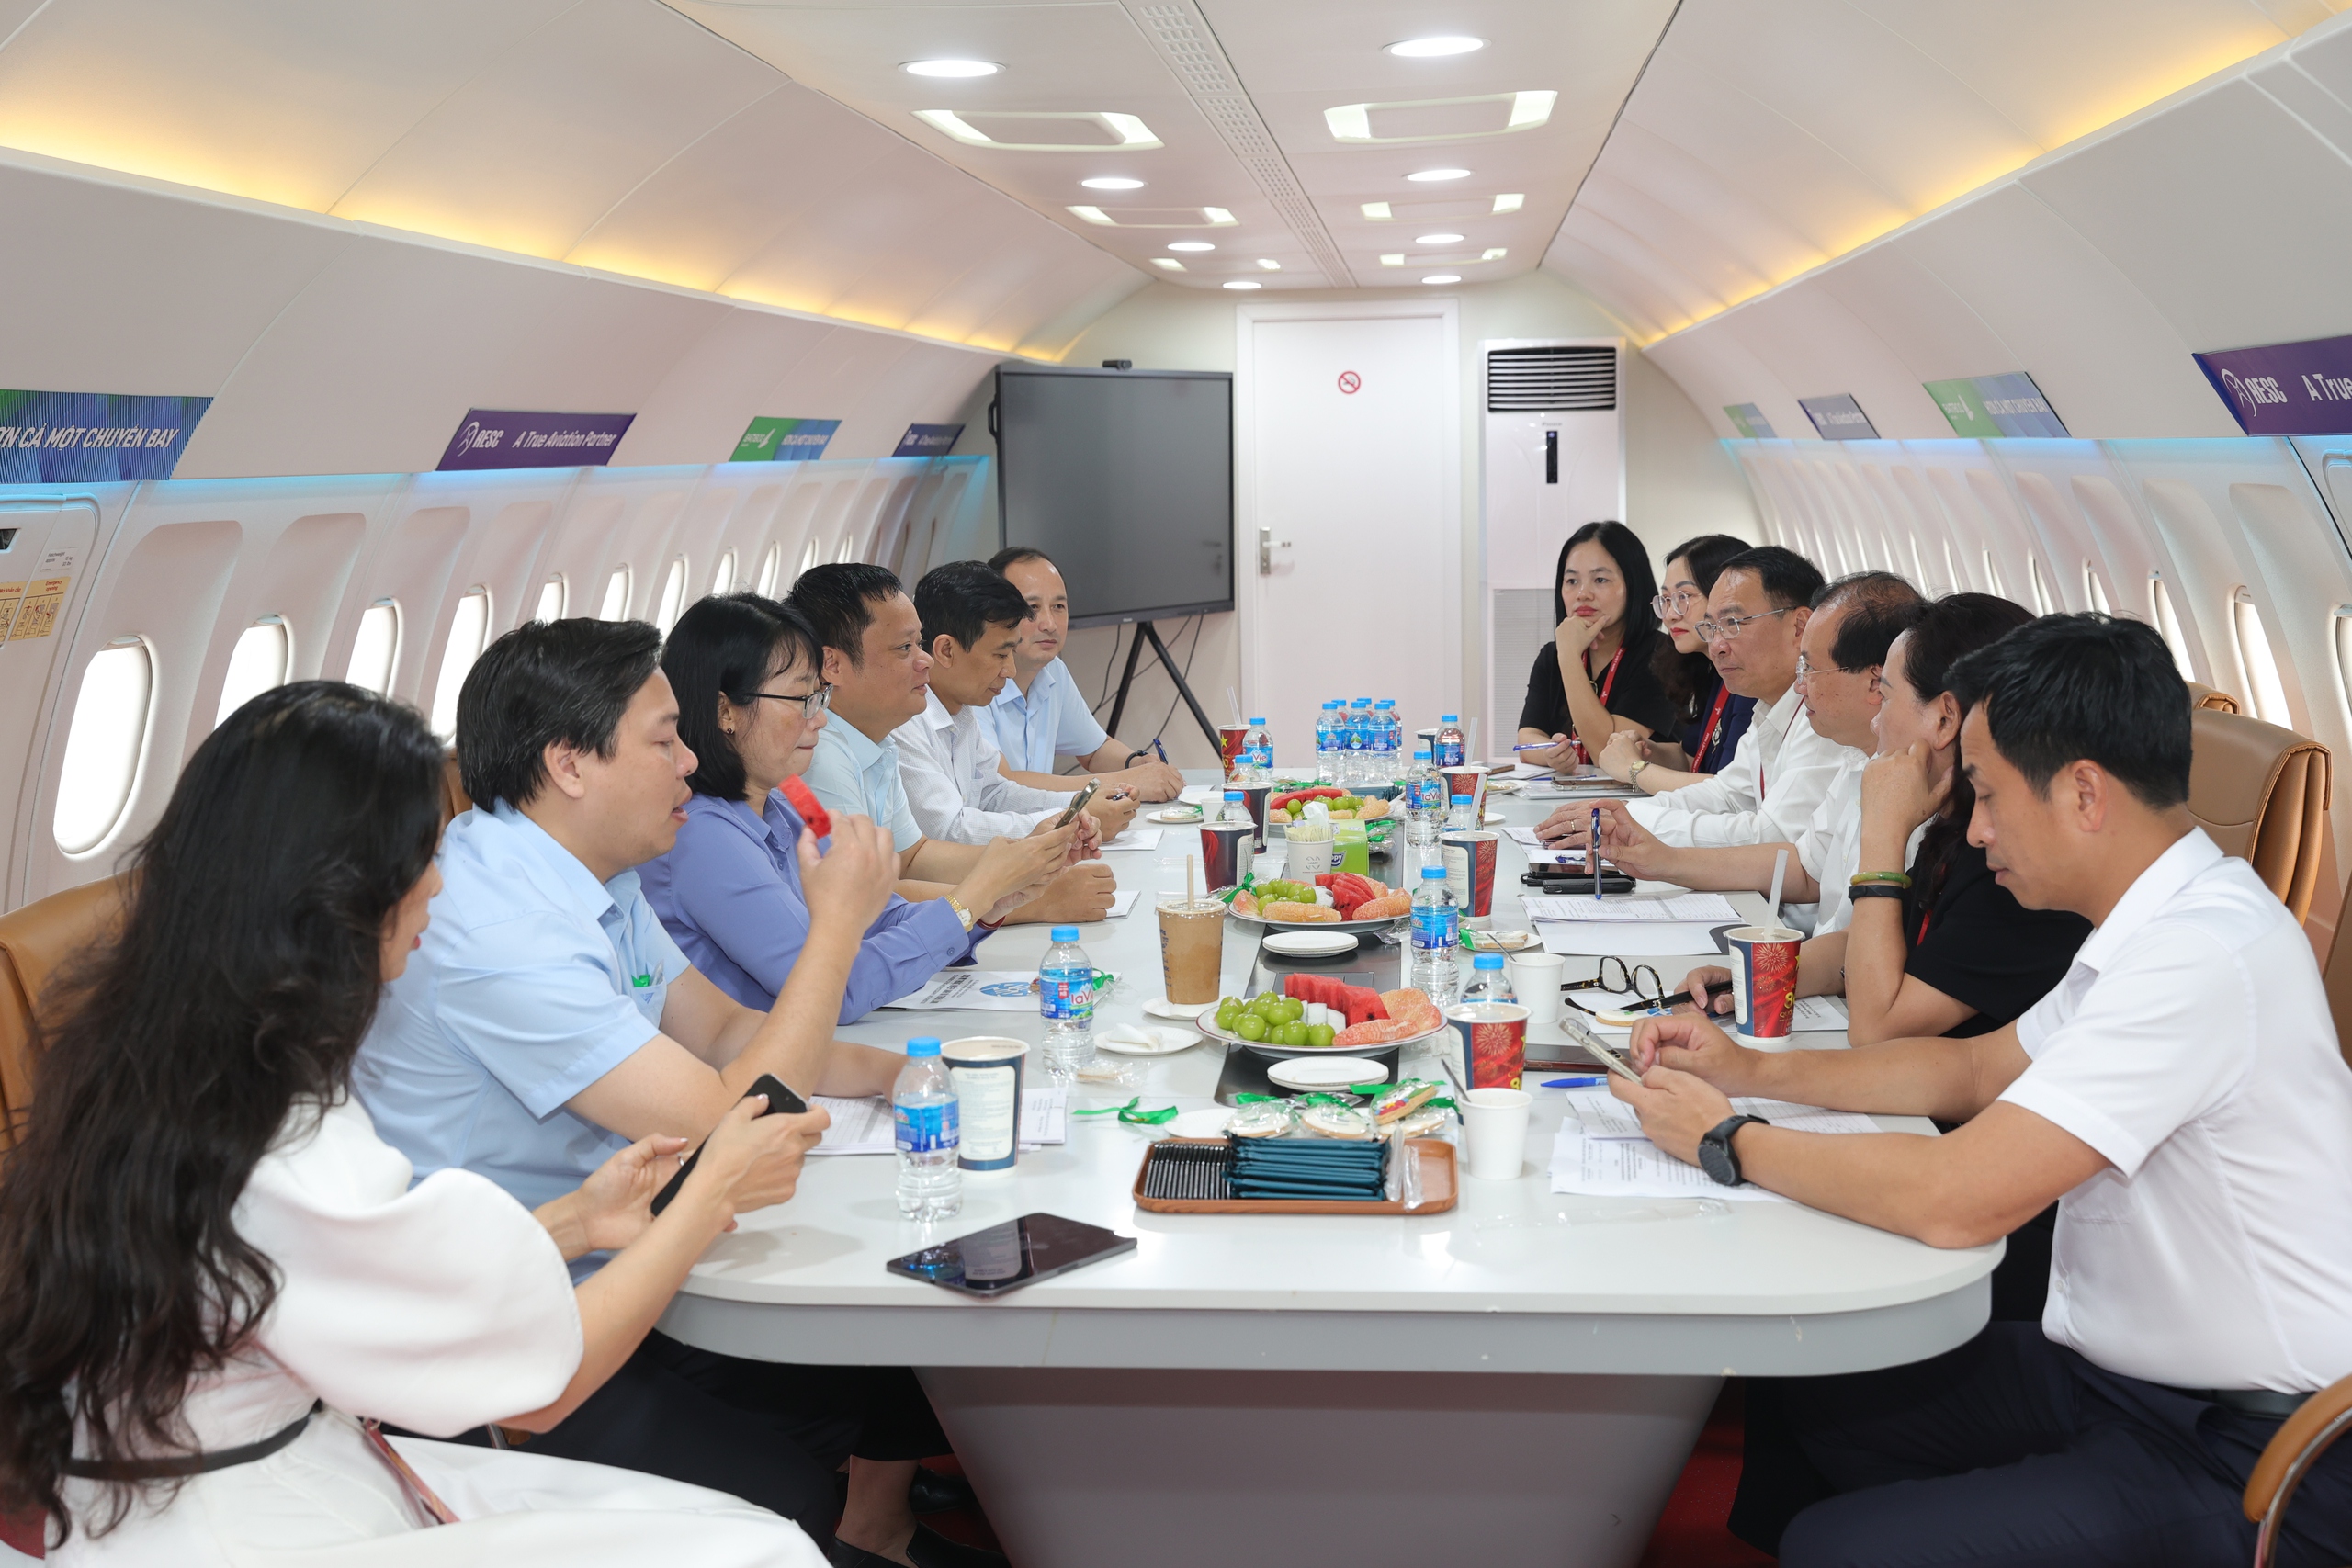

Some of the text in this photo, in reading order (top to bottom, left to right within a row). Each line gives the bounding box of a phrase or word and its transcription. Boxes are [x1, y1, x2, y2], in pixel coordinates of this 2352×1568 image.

[2301, 373, 2352, 401] A True
[42, 424, 87, 451] MỘT
[83, 423, 149, 448] CHUYẾN
[144, 428, 180, 448] BAY
[512, 429, 617, 448] A True Aviation Partner
[1252, 753, 1267, 761] Vie
[1070, 988, 1094, 1004] laVi
